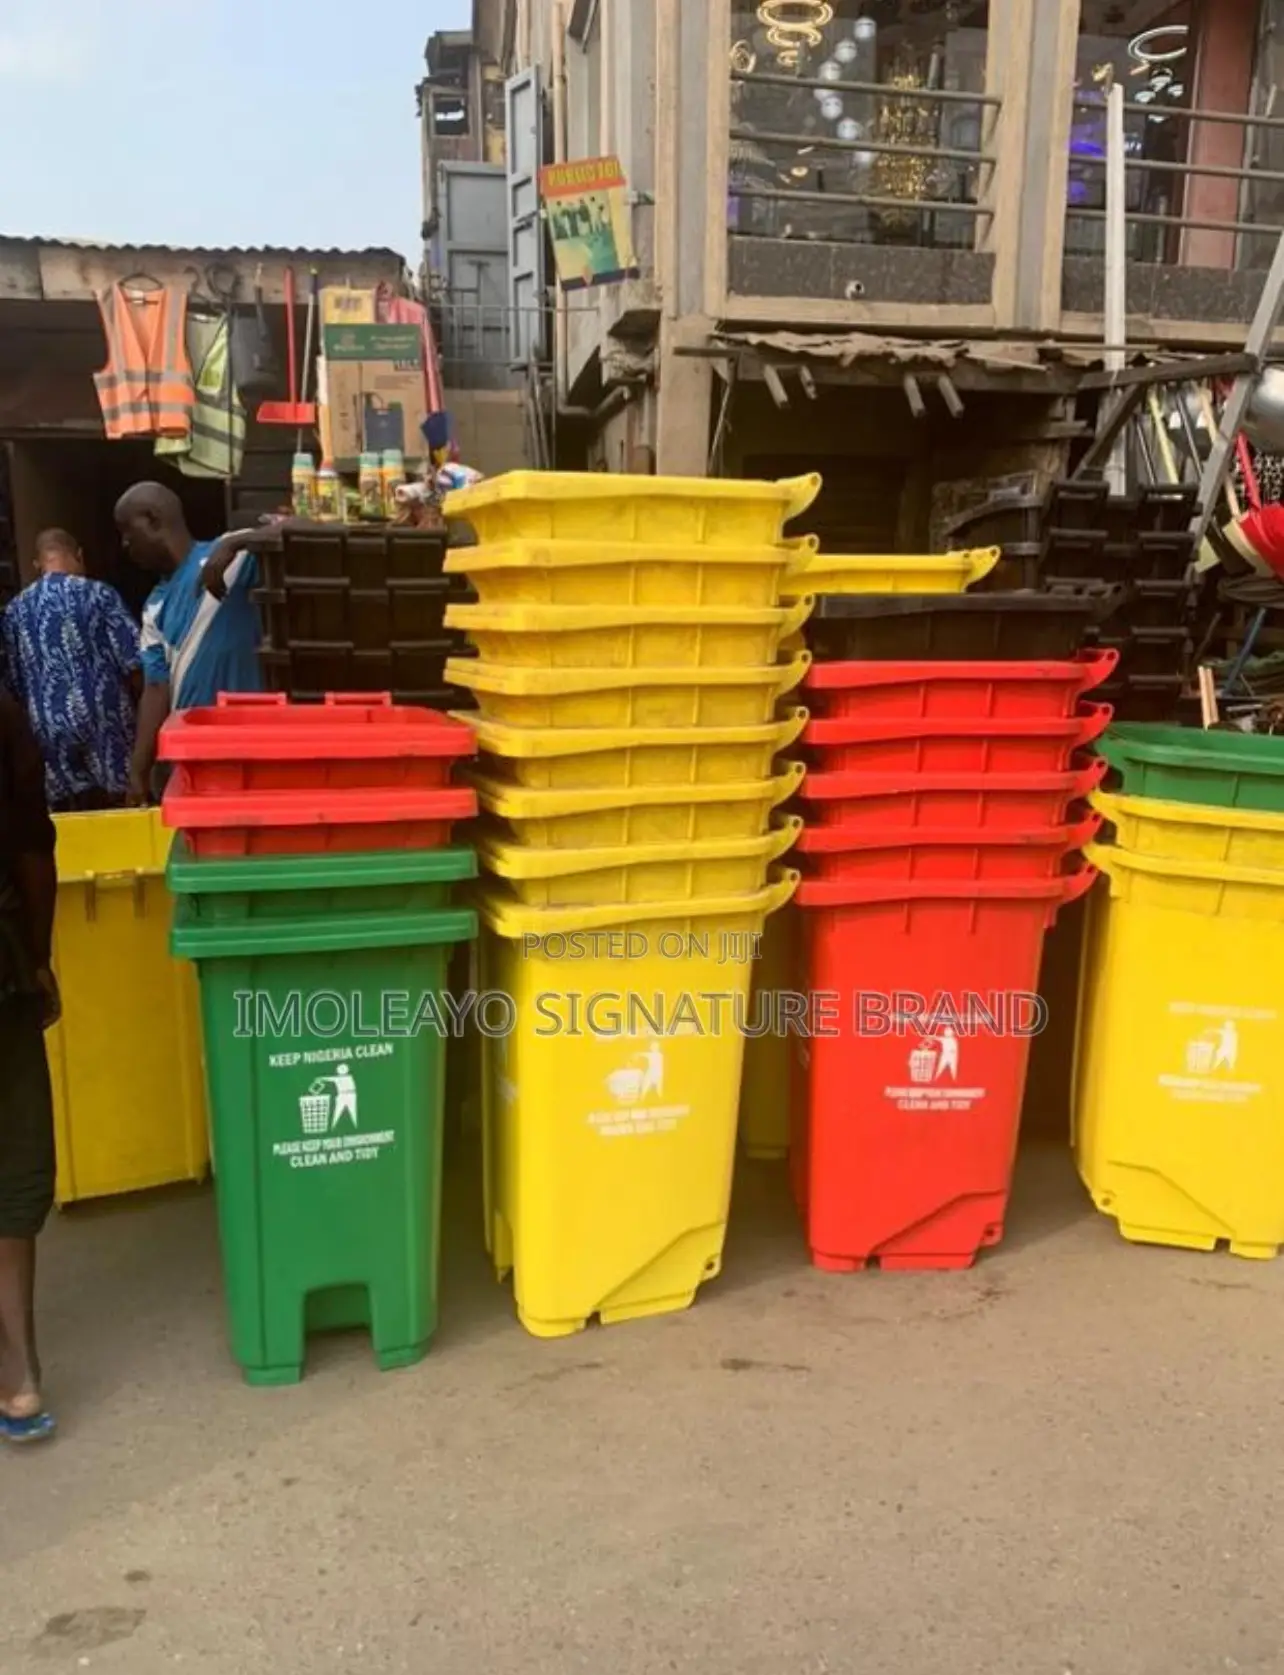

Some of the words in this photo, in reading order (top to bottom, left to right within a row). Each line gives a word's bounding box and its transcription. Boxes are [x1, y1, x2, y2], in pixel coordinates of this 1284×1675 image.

[268, 1052, 302, 1069] KEEP
[303, 1046, 354, 1065] NIGERIA
[355, 1041, 395, 1059] CLEAN
[289, 1153, 328, 1169] CLEAN
[329, 1150, 354, 1165] AND
